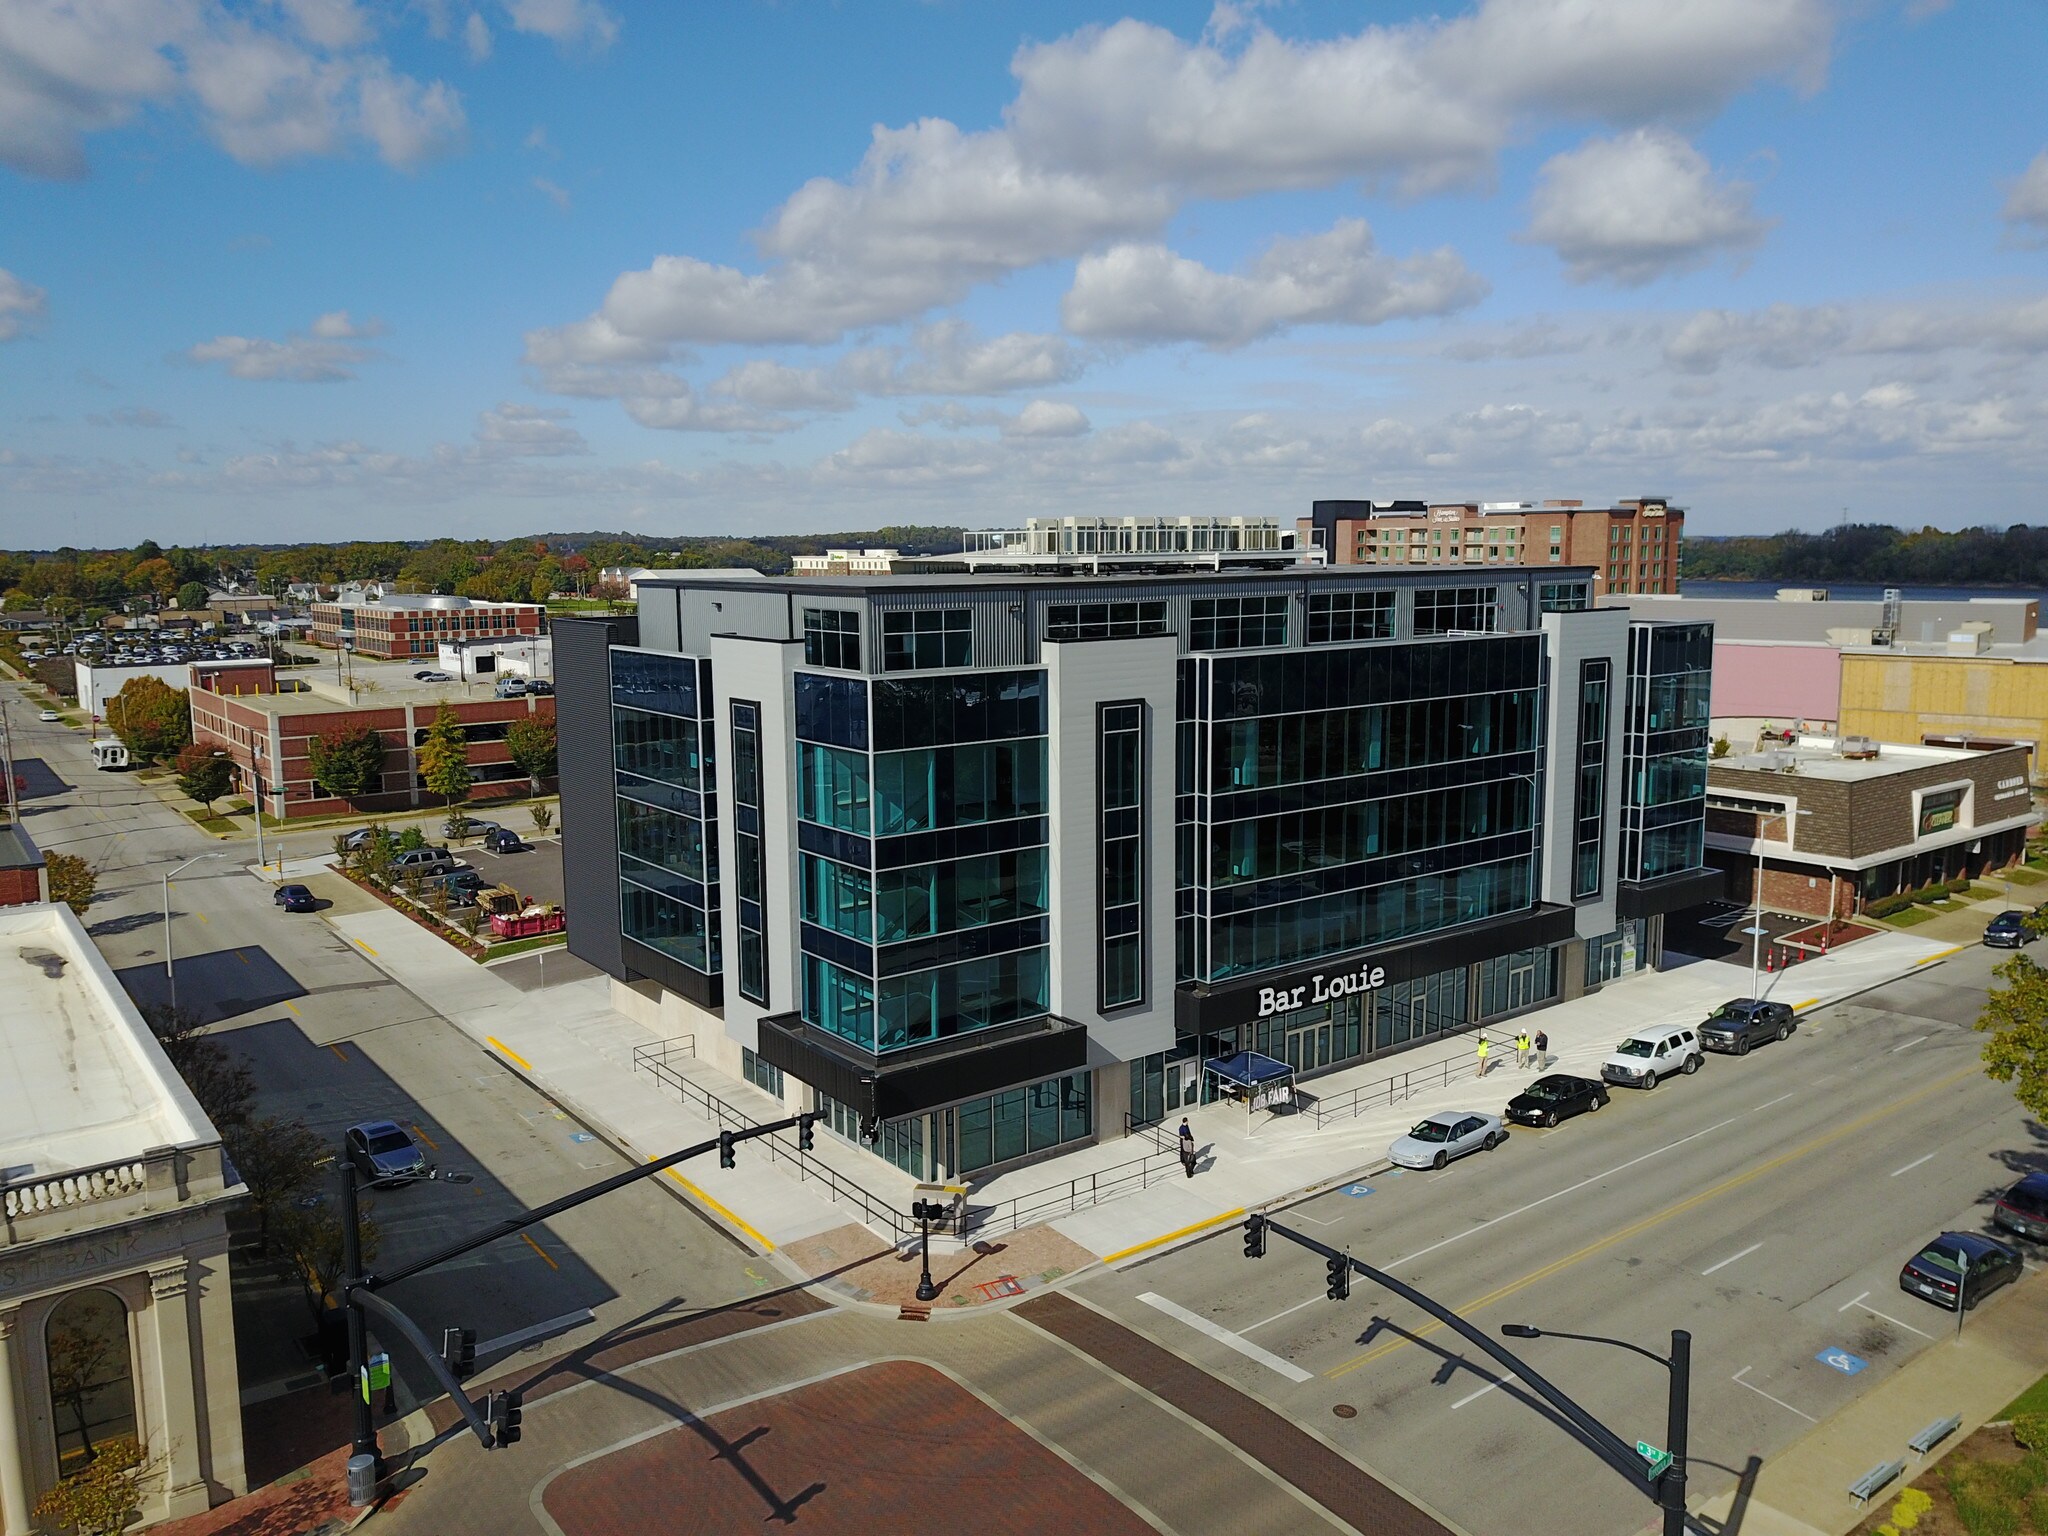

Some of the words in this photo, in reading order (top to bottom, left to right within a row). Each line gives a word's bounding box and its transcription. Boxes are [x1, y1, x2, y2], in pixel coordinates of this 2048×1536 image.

[1258, 985, 1305, 1017] Bar
[1312, 964, 1385, 1003] Louie
[1251, 1093, 1267, 1111] JOB
[1268, 1087, 1289, 1104] FAIR
